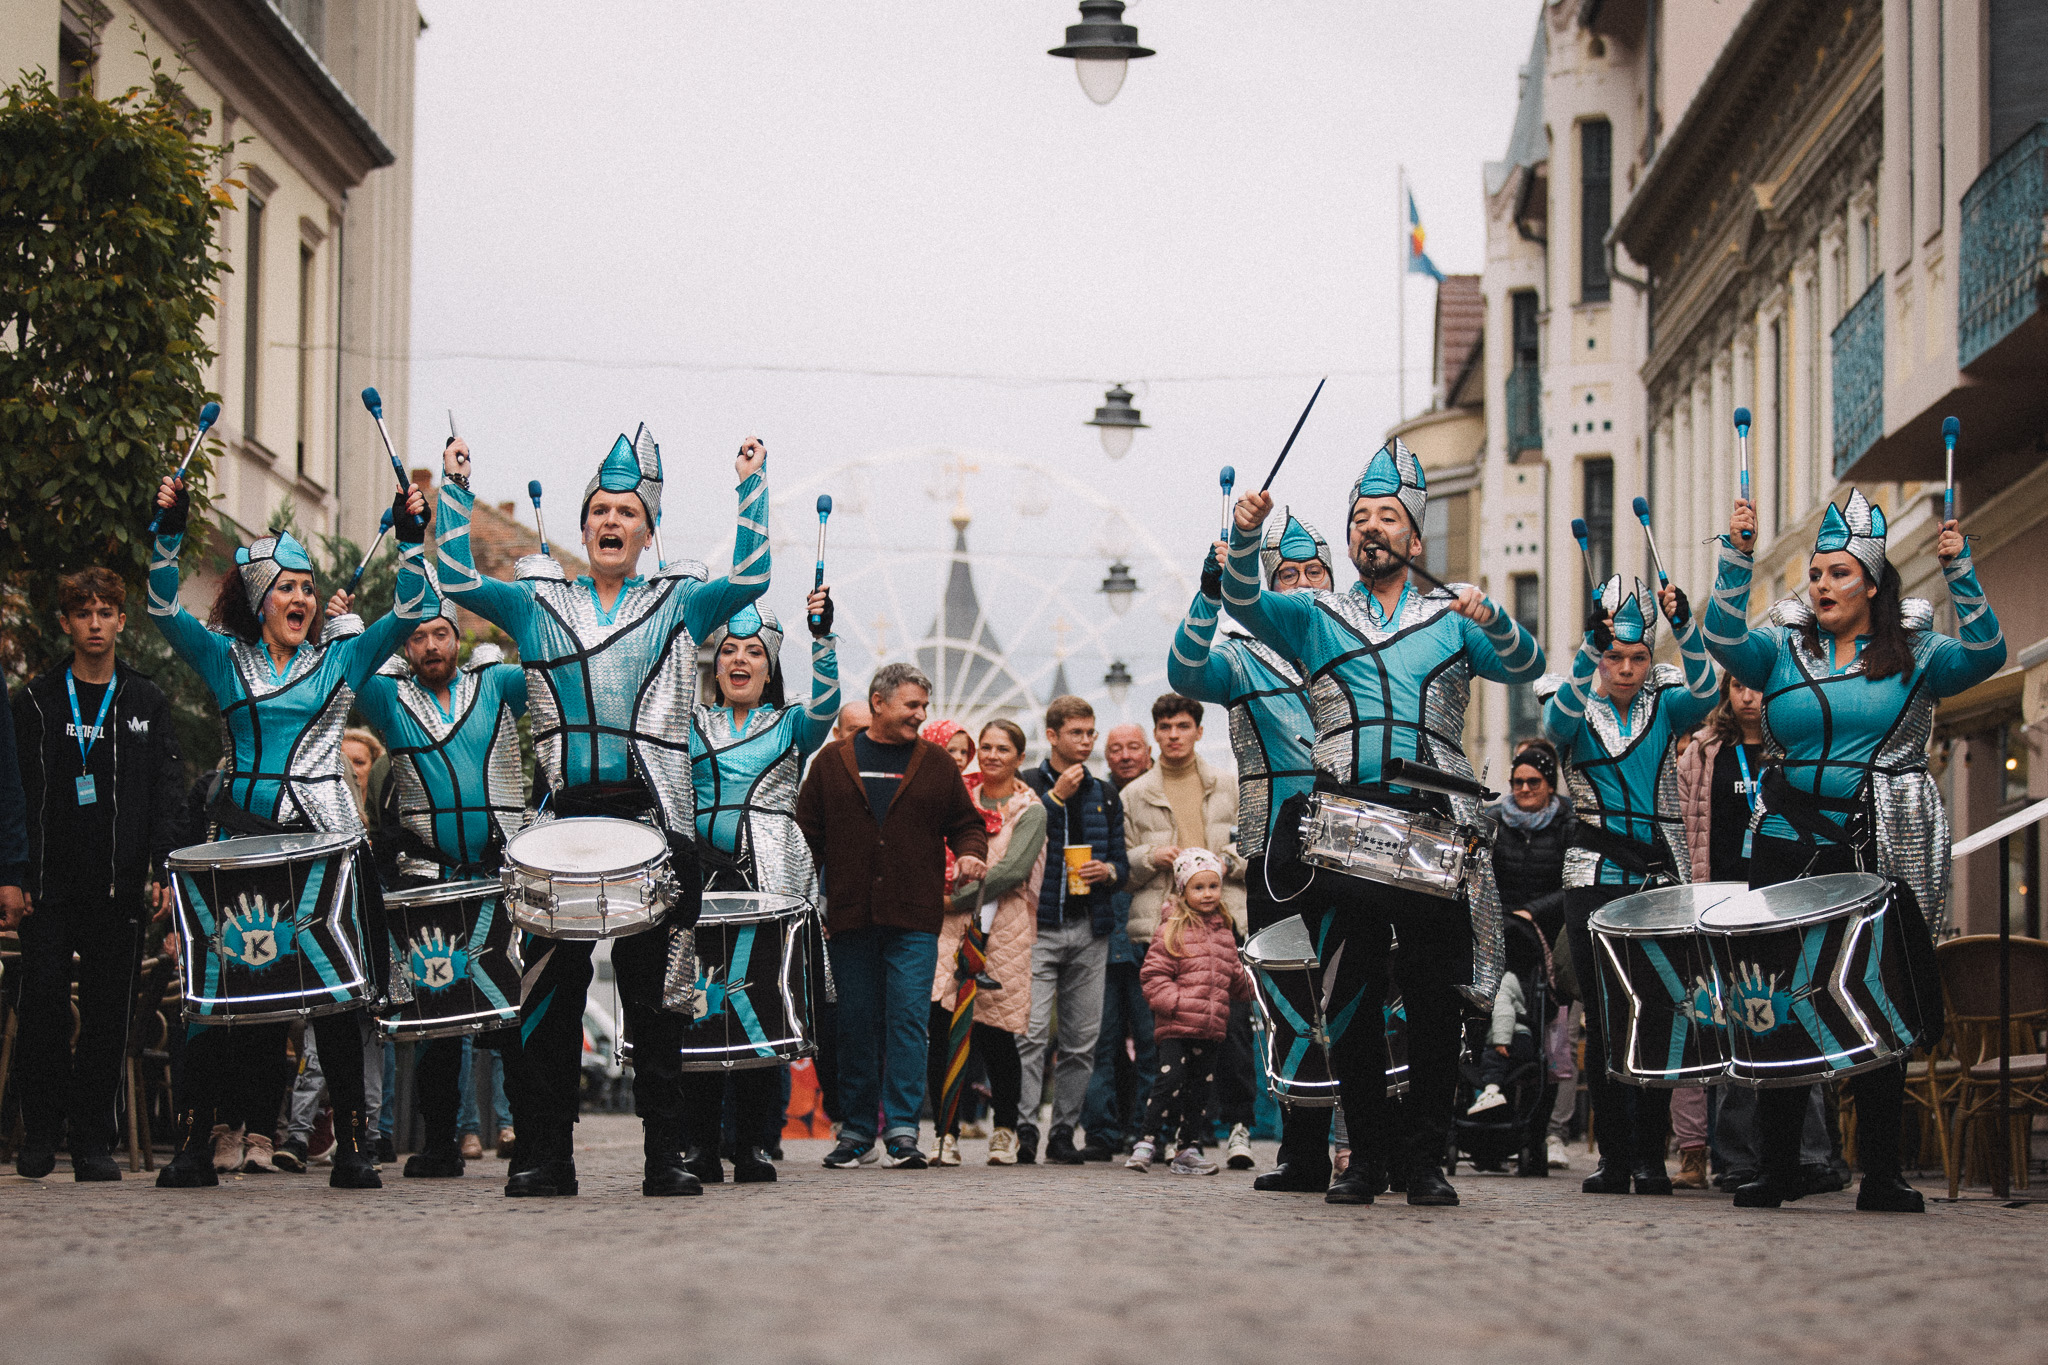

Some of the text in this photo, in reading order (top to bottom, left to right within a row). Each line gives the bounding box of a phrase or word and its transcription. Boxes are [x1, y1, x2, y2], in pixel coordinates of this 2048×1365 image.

[252, 935, 270, 959] K
[432, 961, 448, 982] K
[1752, 1003, 1768, 1026] K
